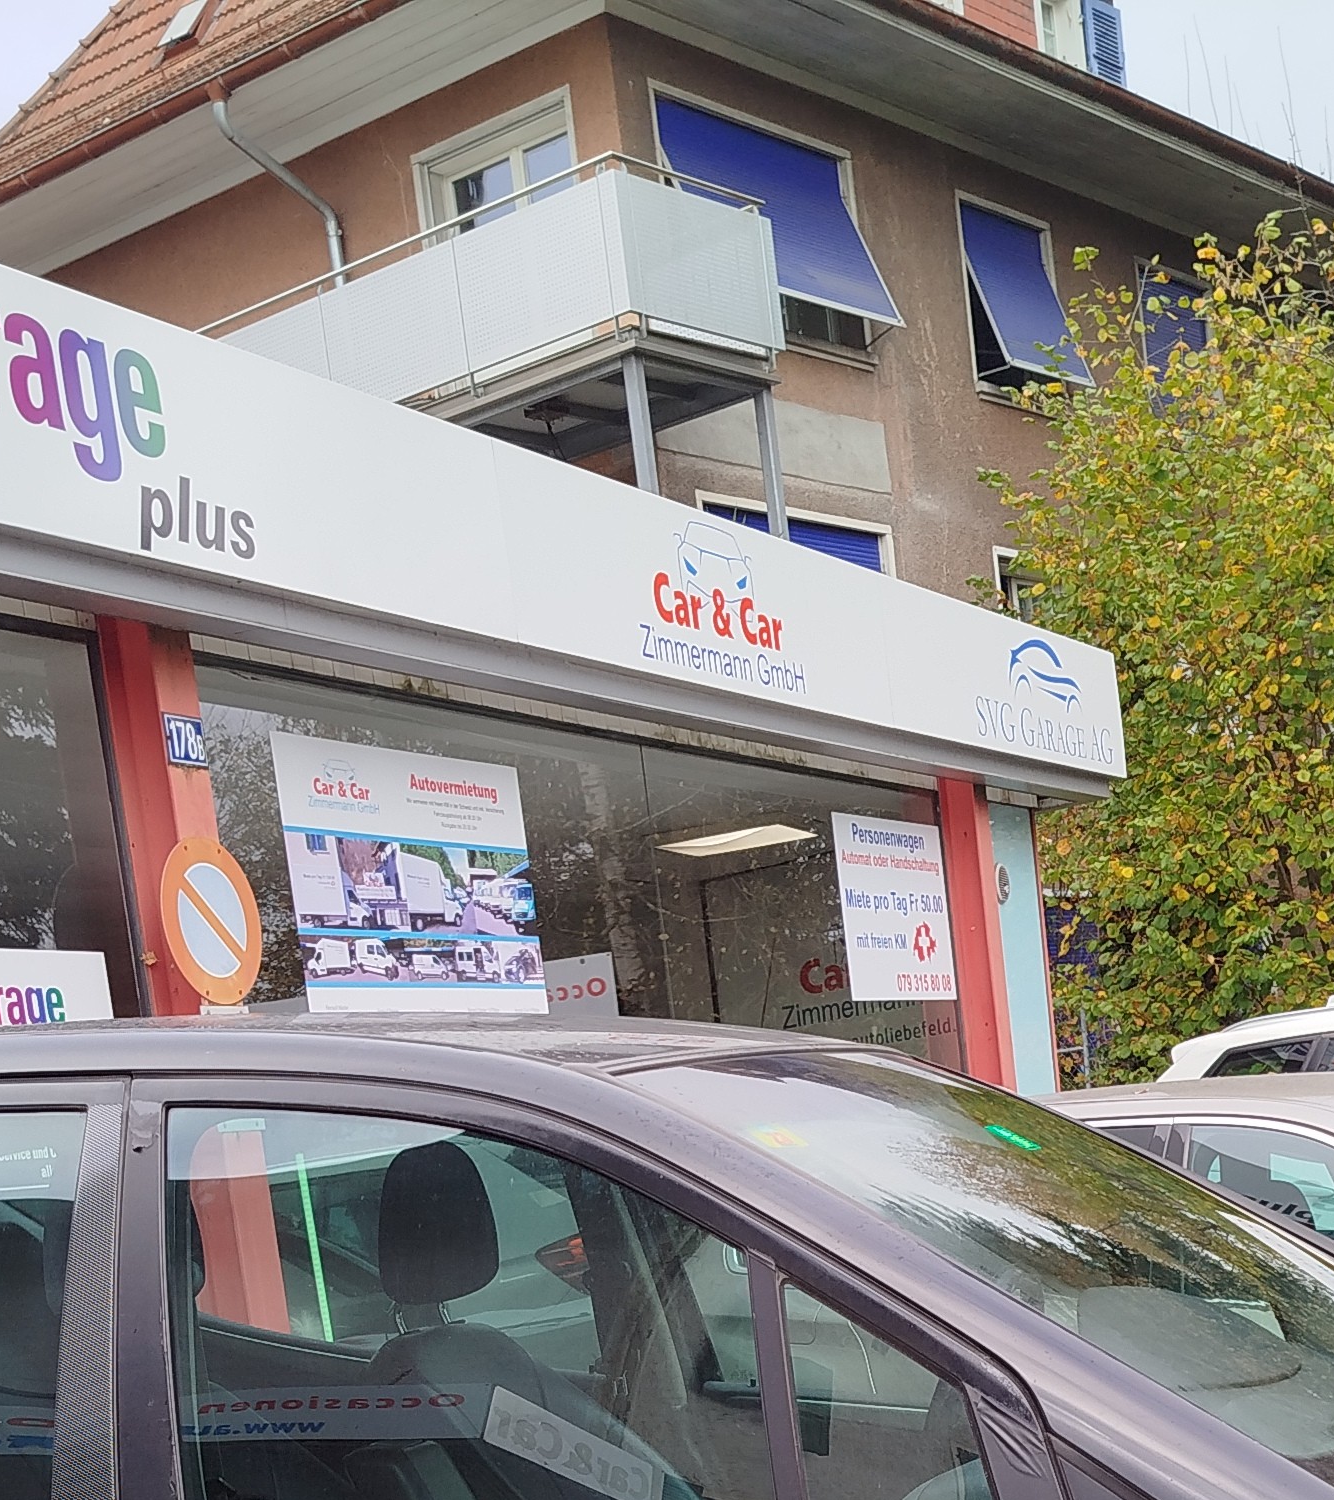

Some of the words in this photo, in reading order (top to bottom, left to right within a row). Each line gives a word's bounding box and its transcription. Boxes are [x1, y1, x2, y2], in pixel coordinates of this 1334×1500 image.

[140, 475, 256, 560] plus
[653, 572, 701, 630] Car
[712, 588, 734, 639] &
[740, 597, 783, 651] Car
[639, 623, 754, 682] Zimmermann
[757, 653, 806, 695] GmbH
[975, 695, 1016, 742] SVG
[1090, 724, 1114, 765] AG
[313, 777, 334, 796] Car
[337, 780, 348, 799] &
[349, 782, 371, 801] Car
[410, 773, 498, 804] Autovermietung
[851, 822, 925, 853] Personenwagen
[841, 849, 872, 866] Automat
[874, 853, 889, 868] oder
[890, 854, 940, 876] Handschaltung
[845, 888, 872, 909] Miete
[874, 895, 889, 914] pro
[890, 891, 908, 916] Tag
[909, 893, 919, 912] Fr
[920, 894, 944, 914] 50.00
[856, 932, 870, 949] mit
[871, 932, 894, 949] freien
[894, 933, 907, 949] KM
[896, 973, 912, 992] 079
[913, 973, 929, 992] 315
